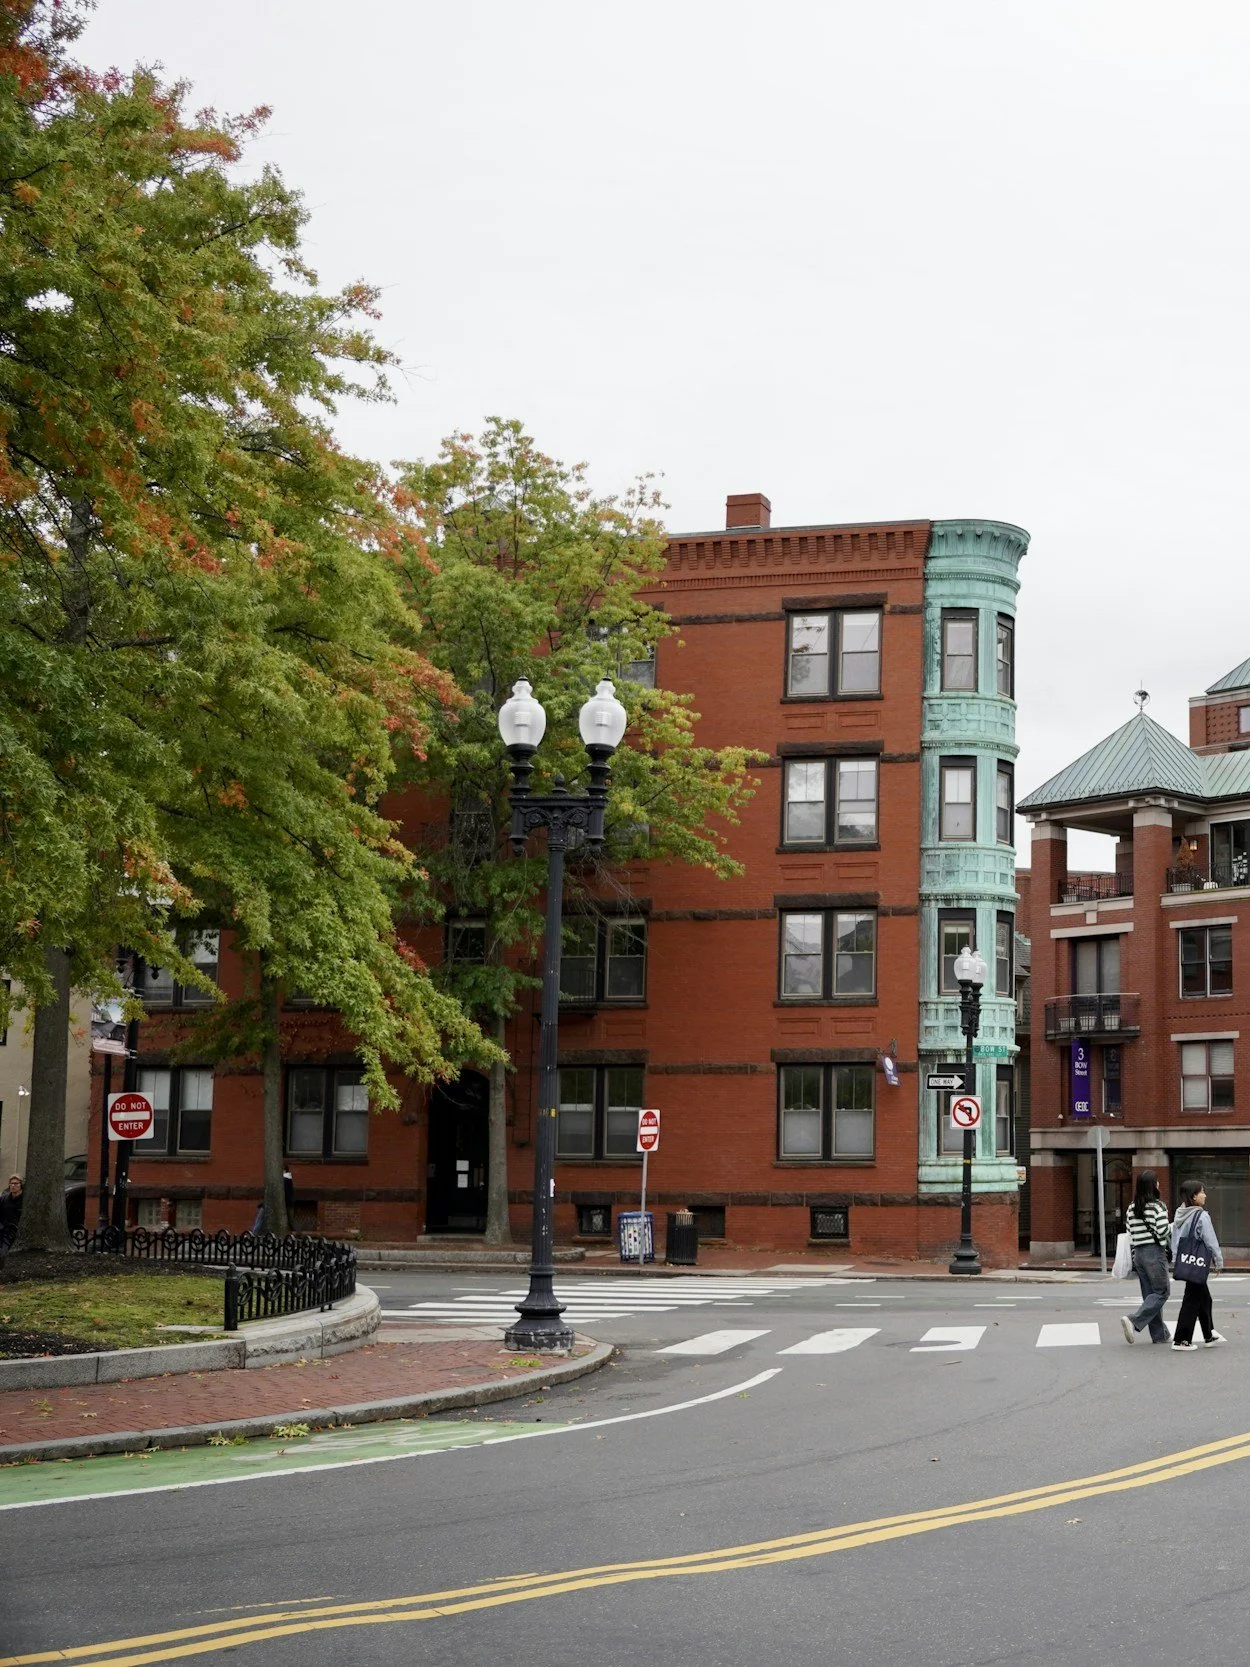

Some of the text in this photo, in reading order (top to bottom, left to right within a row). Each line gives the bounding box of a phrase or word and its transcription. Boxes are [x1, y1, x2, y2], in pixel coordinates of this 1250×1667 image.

[980, 1045, 995, 1053] BOW
[1078, 1047, 1085, 1061] 3
[1074, 1061, 1088, 1069] BOW
[930, 1078, 941, 1086] ONE
[118, 1122, 143, 1130] ENTER
